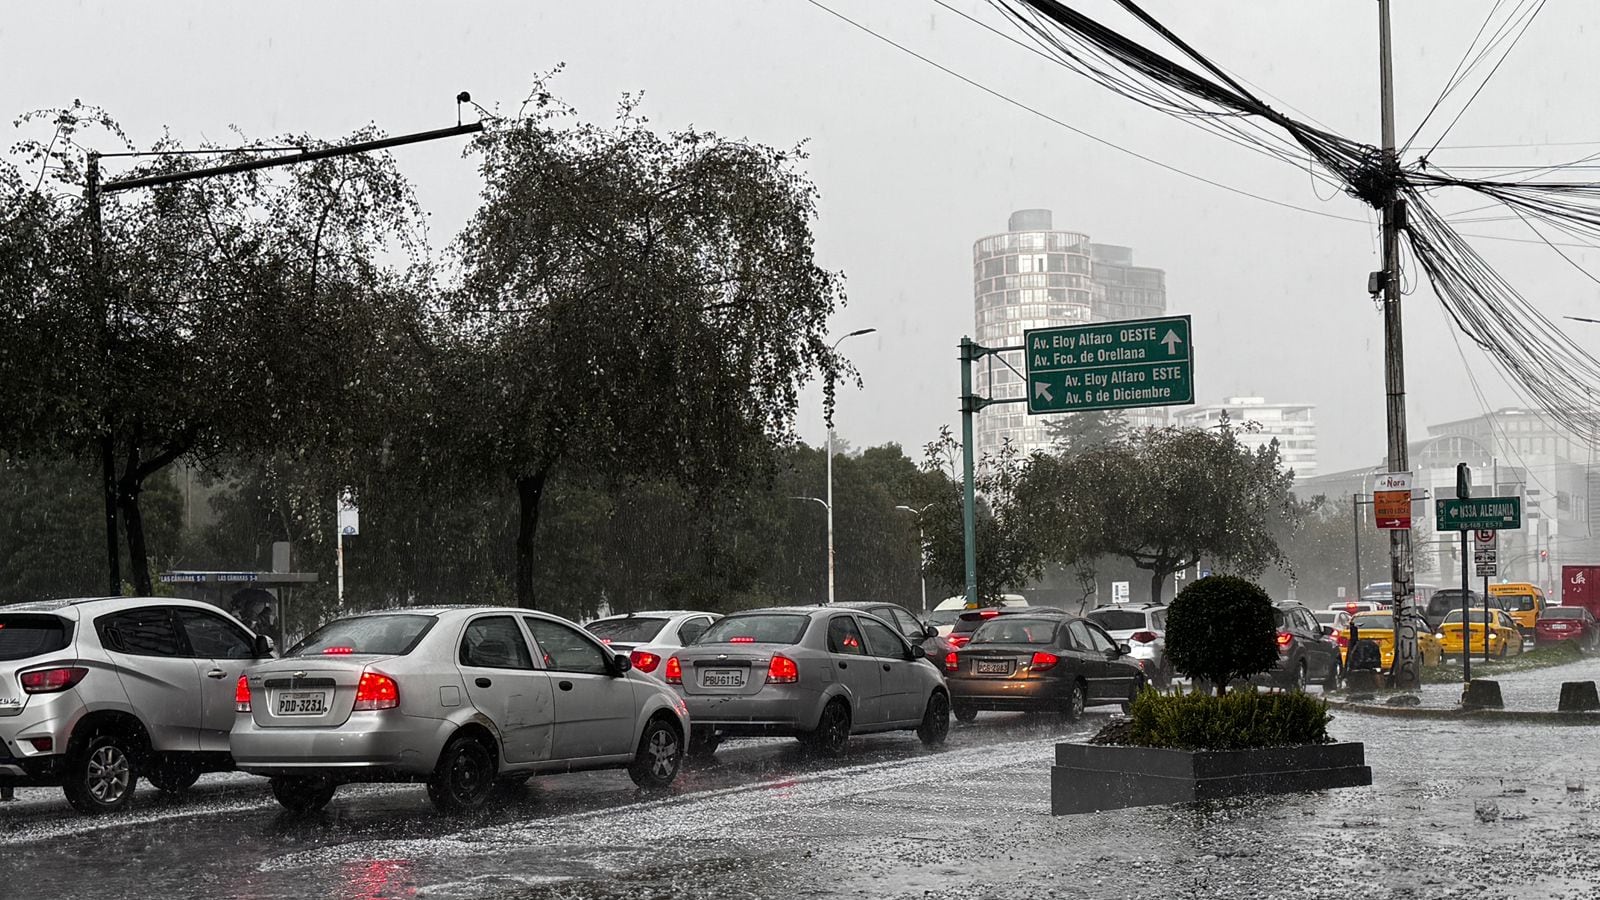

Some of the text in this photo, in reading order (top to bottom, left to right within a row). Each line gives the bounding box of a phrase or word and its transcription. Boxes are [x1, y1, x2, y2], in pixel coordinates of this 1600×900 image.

[1033, 327, 1157, 350] Av. Eloy Alfaro OESTE
[1034, 347, 1146, 367] Av. Fco. de Orellana
[1065, 366, 1181, 387] Av. Eloy Alfaro ESTE
[1066, 386, 1171, 404] Av. 6 de Diciembre
[1460, 503, 1515, 518] N33A ALEMANIA
[705, 675, 740, 685] PBU-6115
[279, 700, 322, 712] PDD-3231
